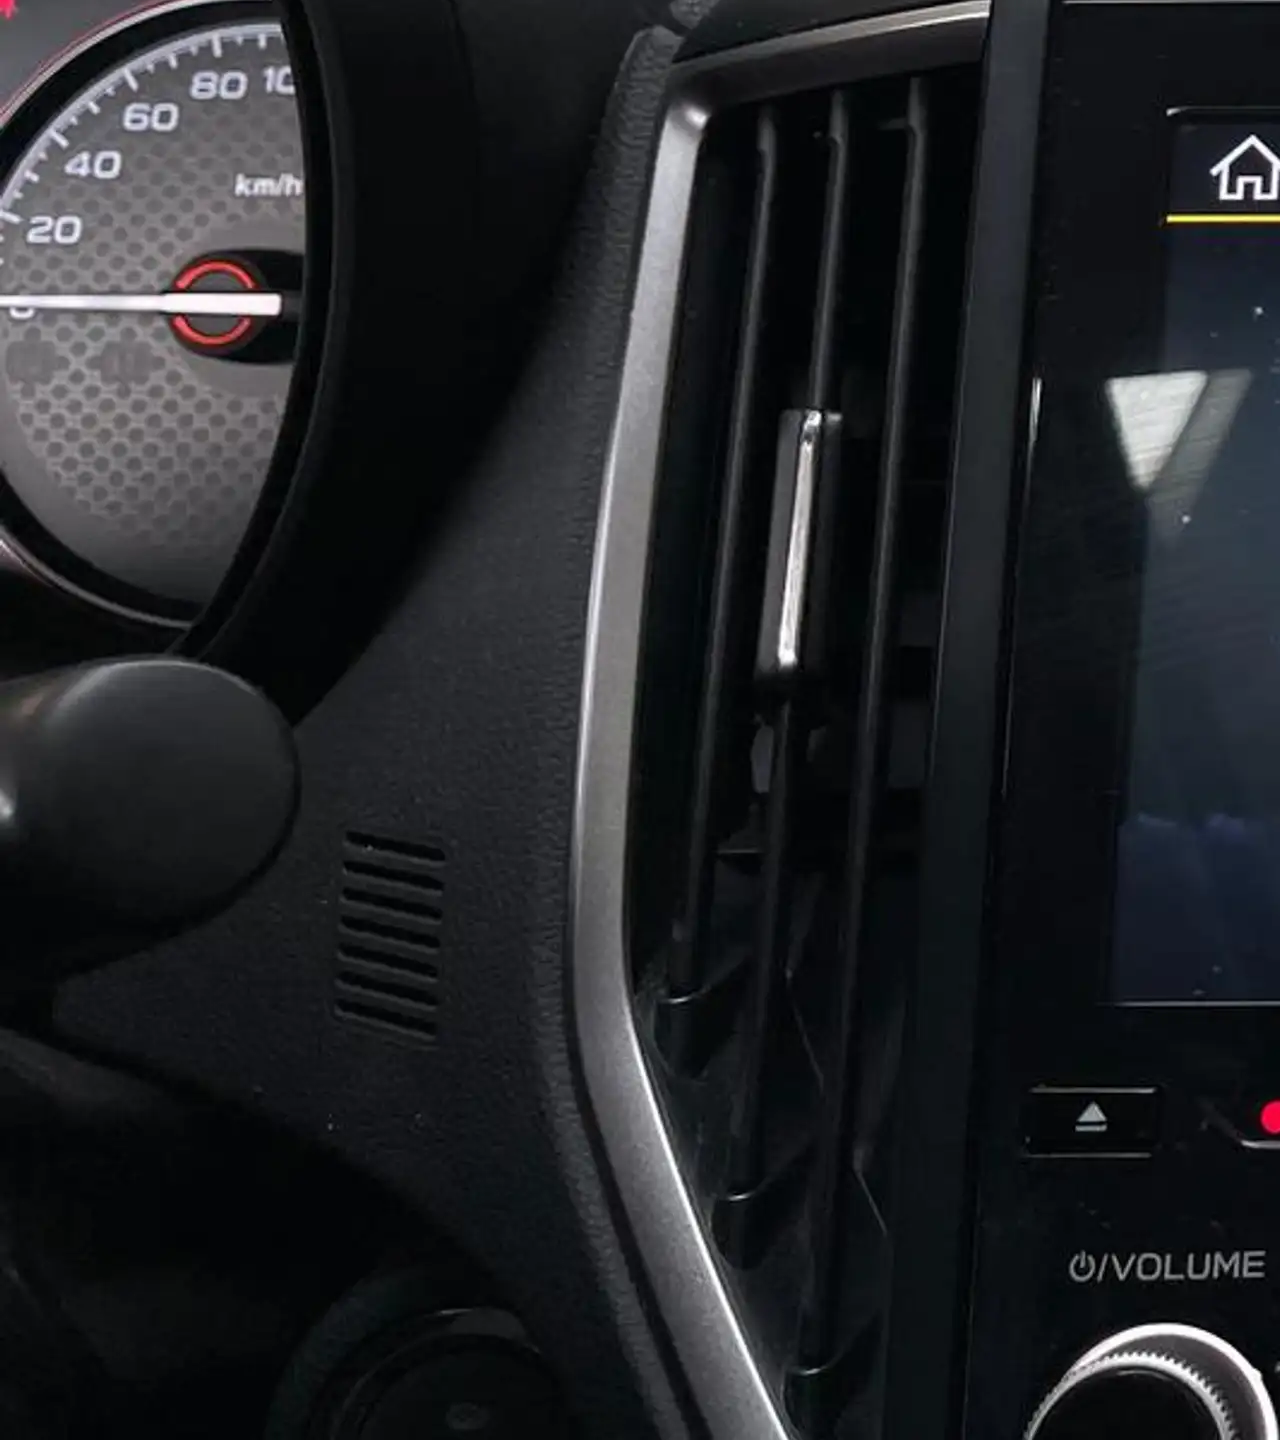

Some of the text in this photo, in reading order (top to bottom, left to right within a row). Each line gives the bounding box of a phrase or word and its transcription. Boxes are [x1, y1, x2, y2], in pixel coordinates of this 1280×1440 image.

[190, 71, 248, 100] 80
[122, 102, 179, 131] 60
[64, 150, 122, 179] 40
[234, 174, 303, 197] km/h
[26, 215, 82, 244] 20
